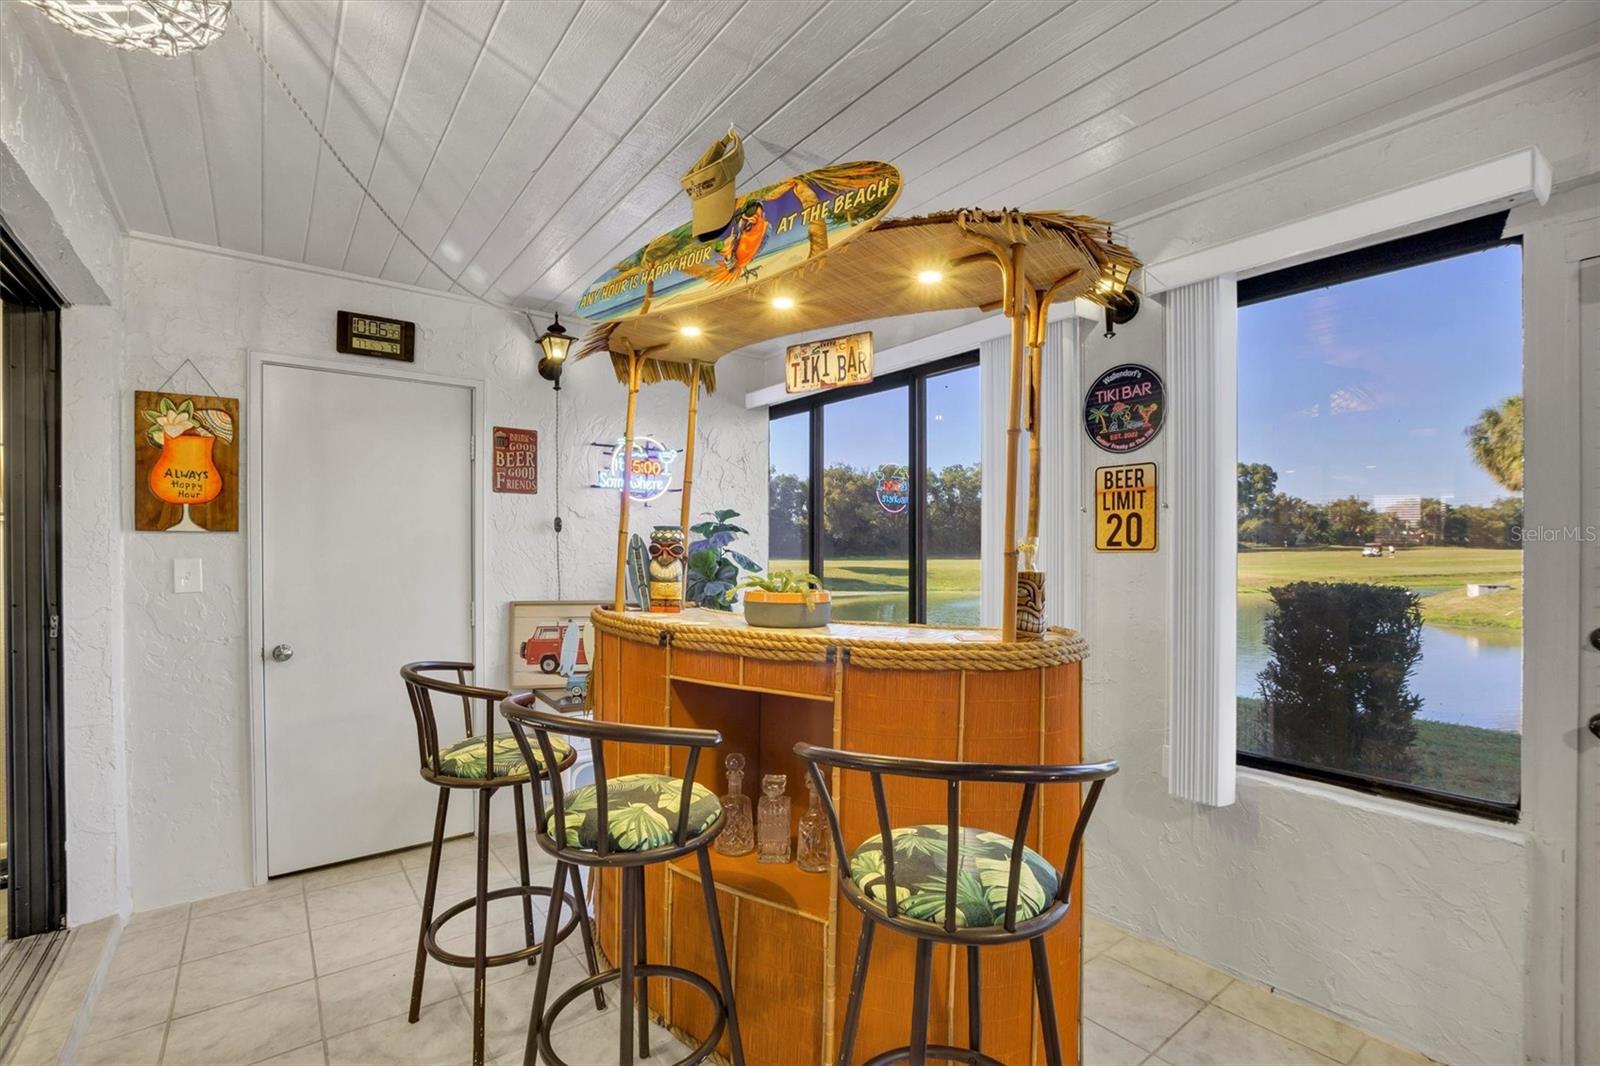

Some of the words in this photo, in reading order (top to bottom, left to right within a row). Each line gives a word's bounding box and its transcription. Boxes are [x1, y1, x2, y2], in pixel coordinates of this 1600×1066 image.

[777, 213, 797, 234] AT
[801, 201, 831, 225] THE
[834, 178, 889, 213] BEACH
[580, 288, 601, 308] ANY
[602, 279, 628, 300] HOUR
[628, 275, 640, 290] IS
[640, 260, 678, 285] HAPPY
[679, 246, 712, 271] HOUR
[791, 350, 830, 387] TIKI
[837, 346, 867, 382] BAR
[1095, 388, 1120, 403] TIKI
[1122, 382, 1152, 400] BAR
[509, 442, 536, 452] GOOD
[496, 451, 535, 467] BEER
[632, 459, 661, 476] 5:00
[163, 468, 209, 481] ALWAYS
[496, 472, 536, 490] FRIENDS
[508, 467, 535, 480] GOOD
[600, 472, 664, 490] Somwhere
[1104, 468, 1144, 489] BEER
[178, 490, 201, 498] Hour
[1103, 490, 1146, 511] LIMIT
[1106, 512, 1142, 547] 20
